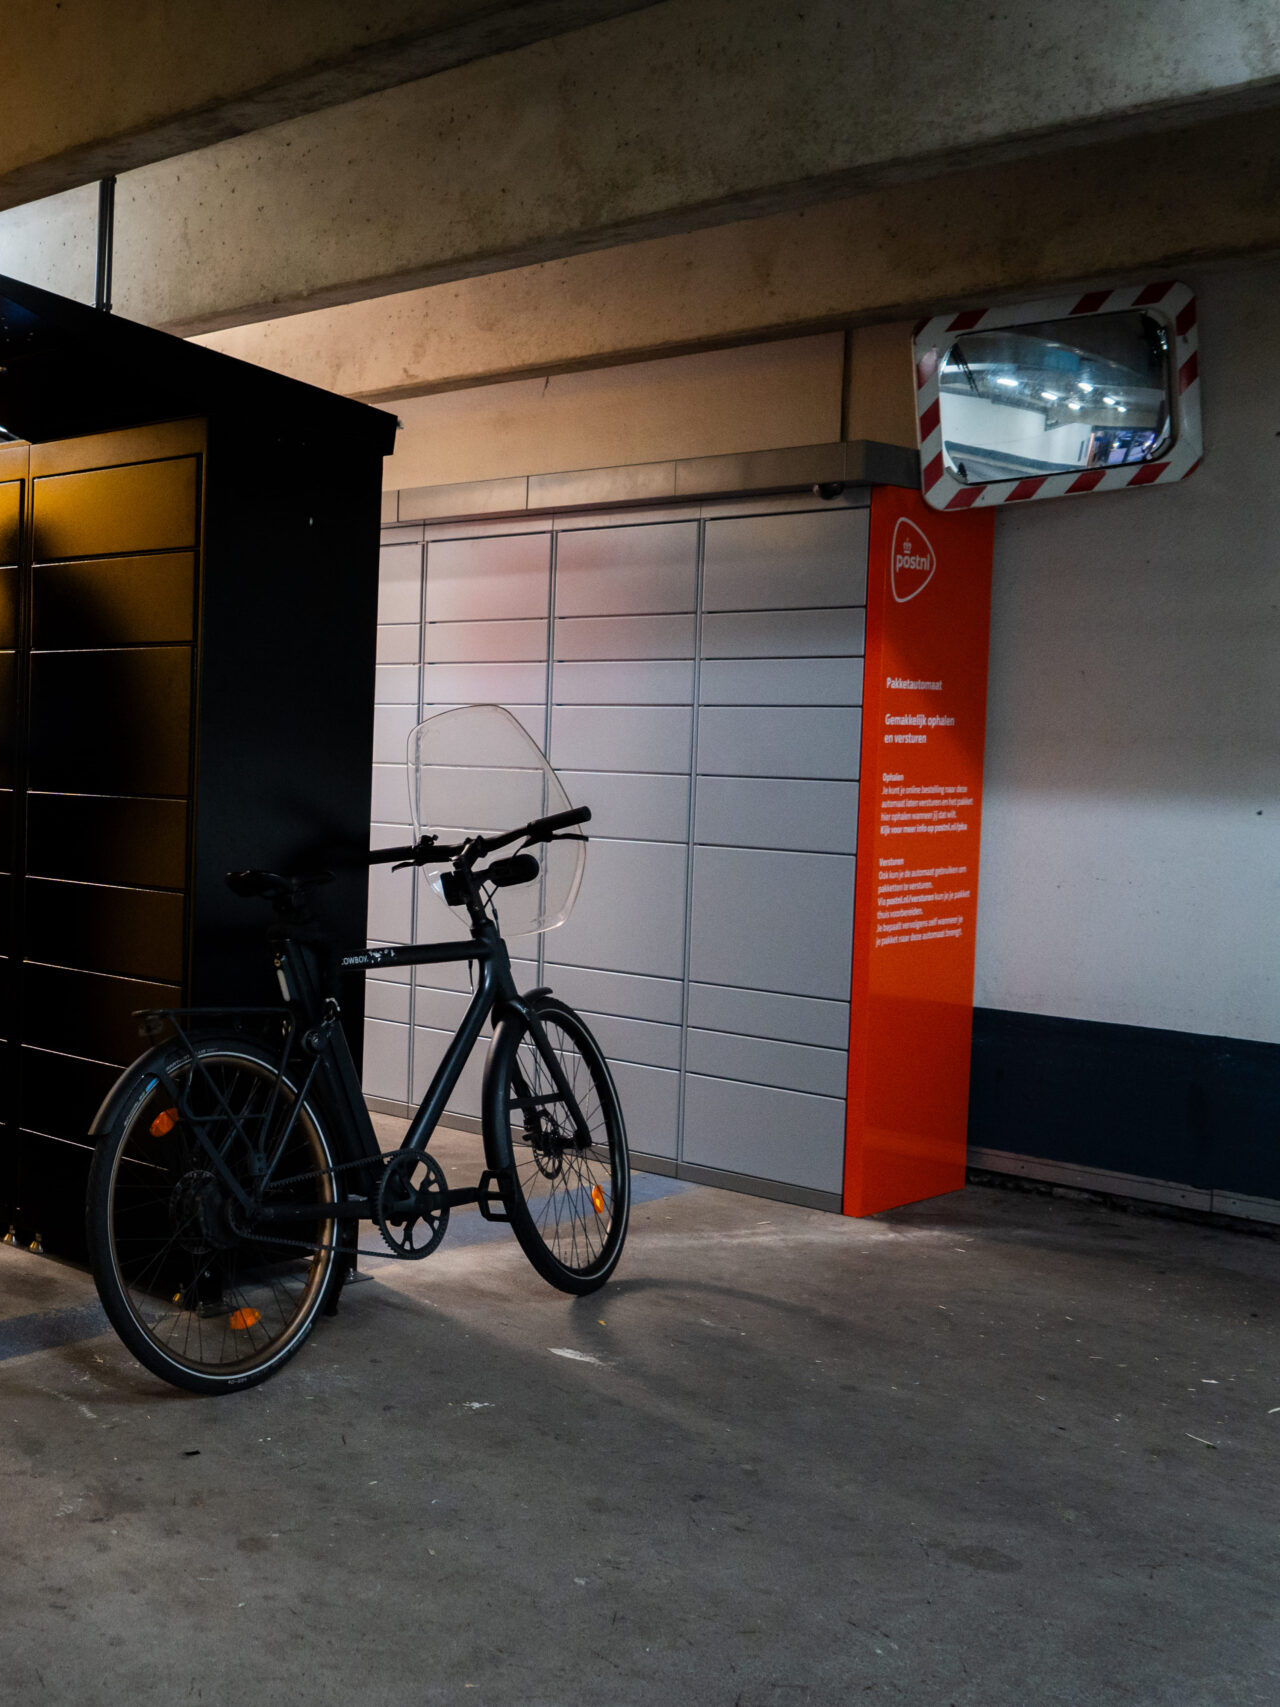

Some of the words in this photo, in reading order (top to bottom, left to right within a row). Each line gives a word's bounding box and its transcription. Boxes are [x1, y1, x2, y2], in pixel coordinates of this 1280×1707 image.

[896, 553, 930, 573] postnl
[886, 677, 943, 691] Pakketautomaat
[885, 713, 926, 729] Gemakkelijk
[927, 715, 955, 729] ophalen
[884, 734, 893, 743] en
[894, 733, 927, 743] versturen
[341, 955, 368, 966] OWBOY
